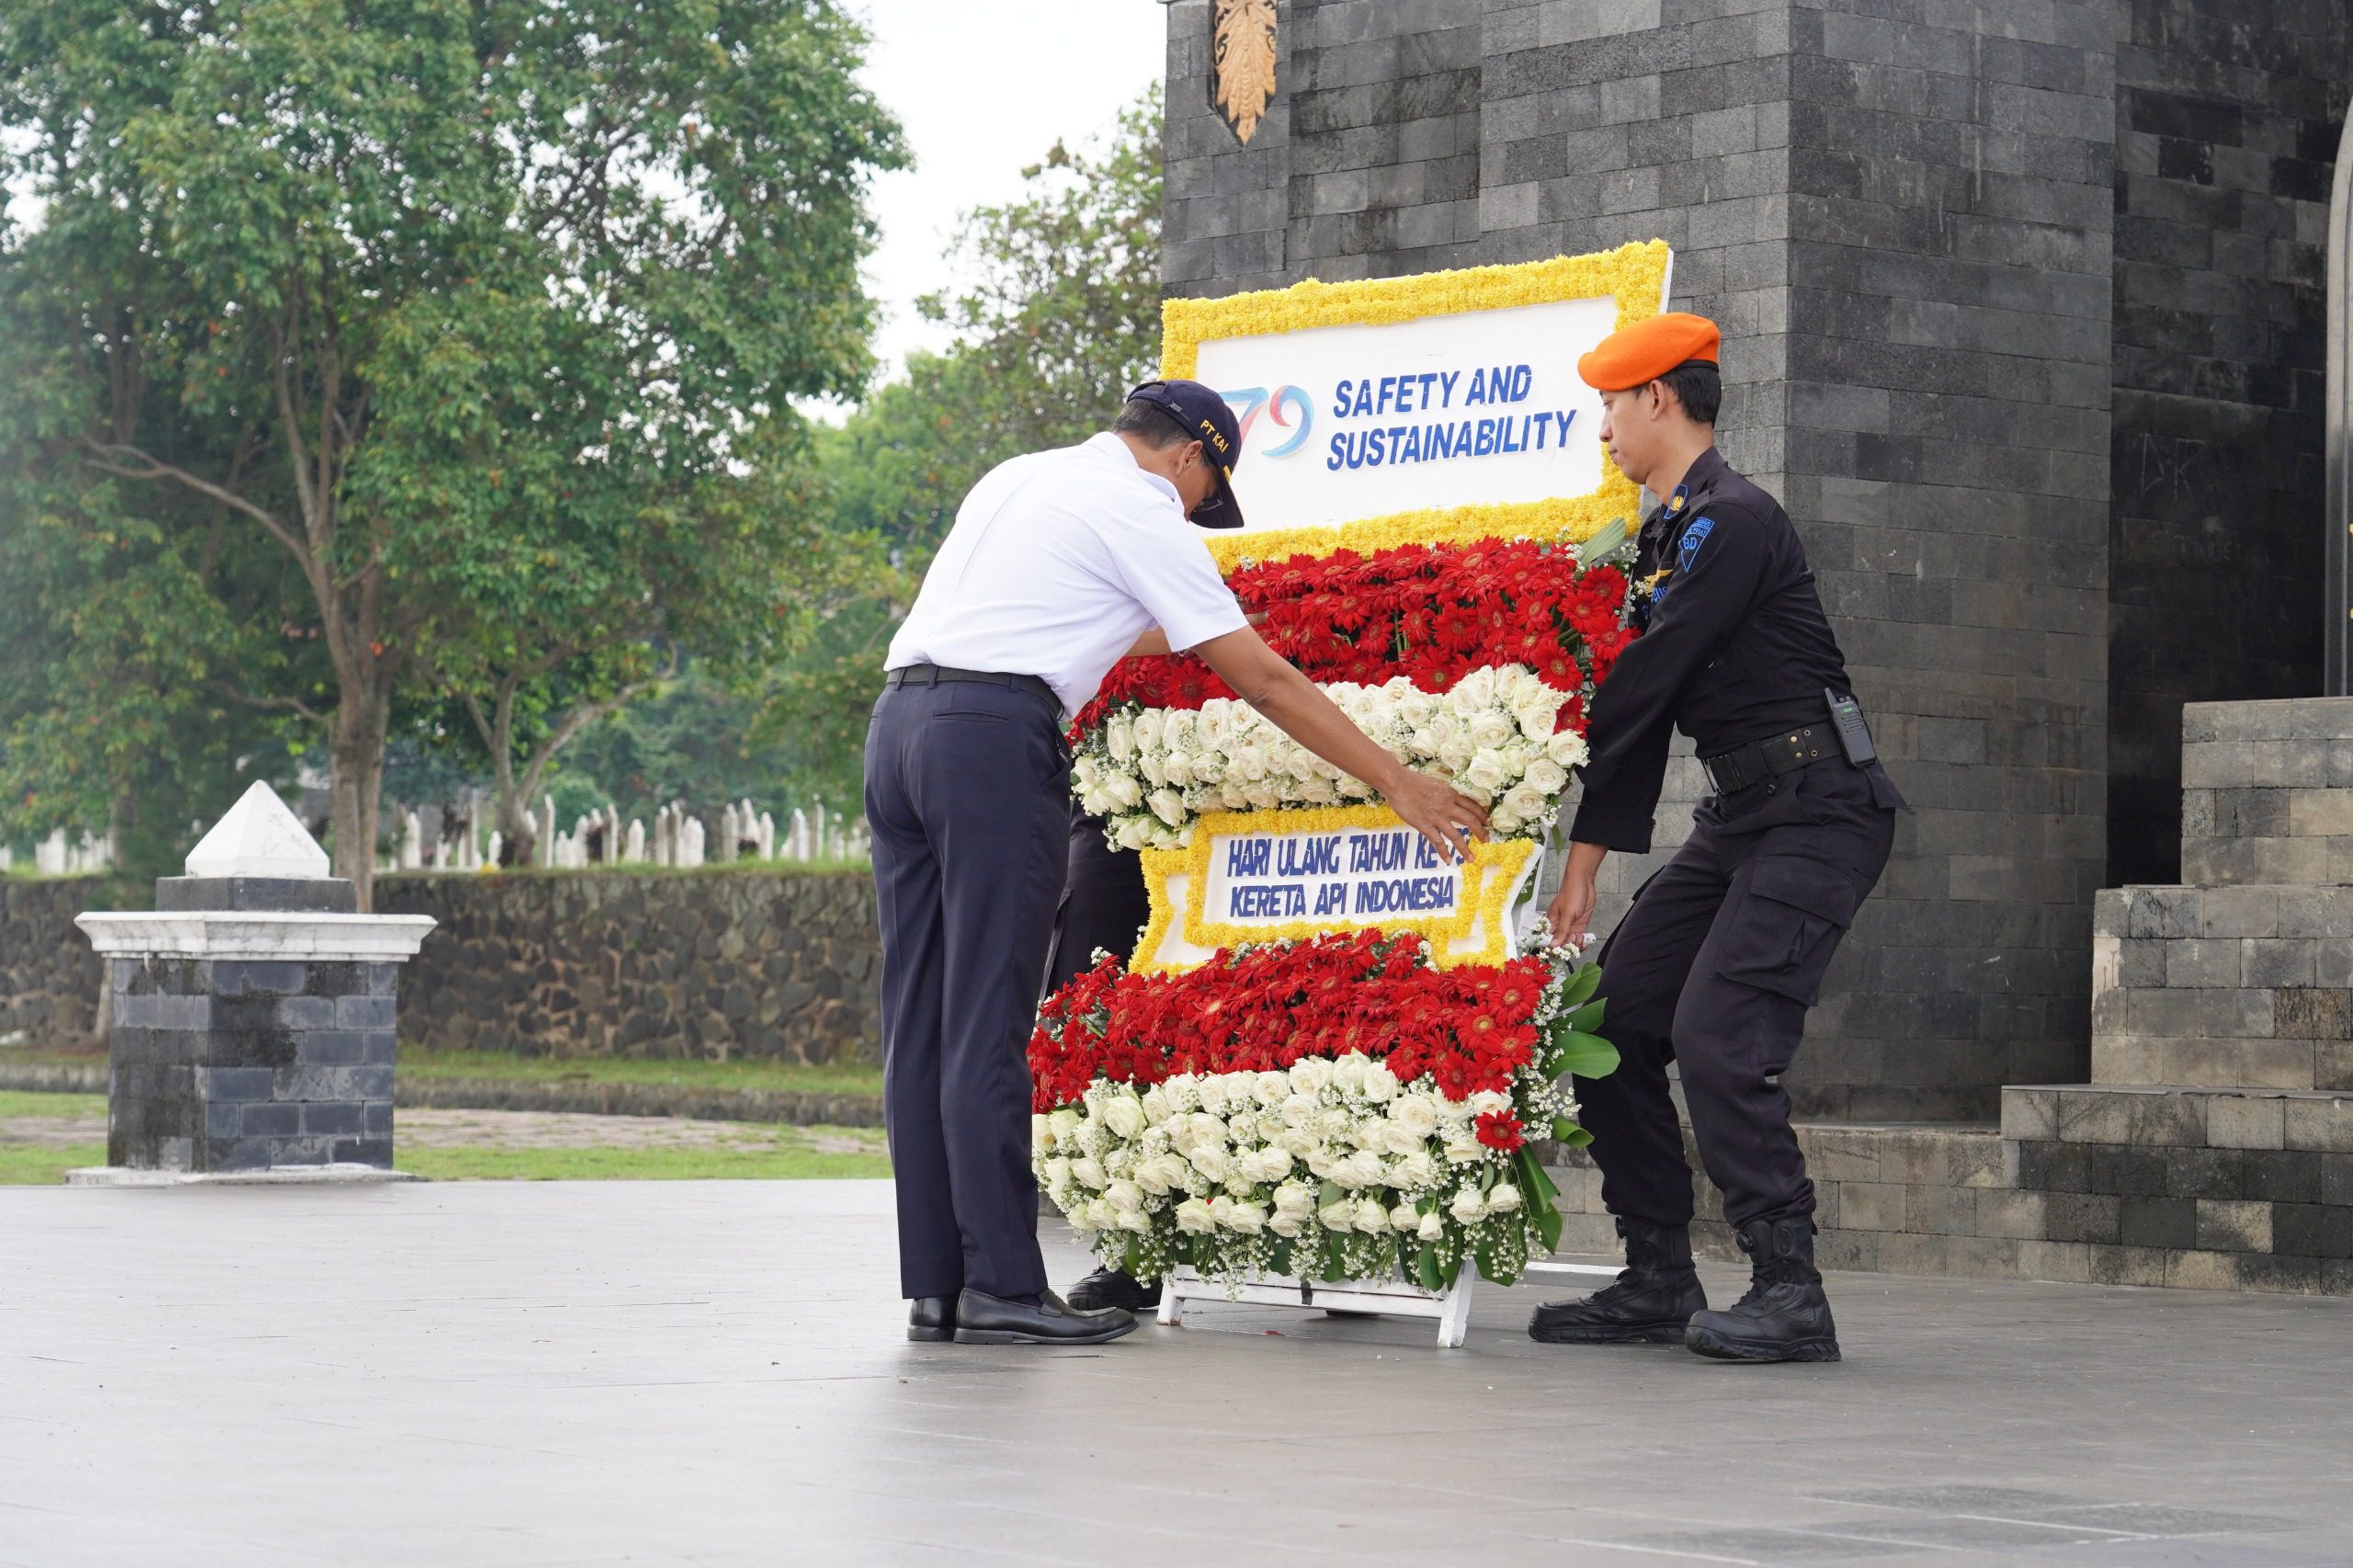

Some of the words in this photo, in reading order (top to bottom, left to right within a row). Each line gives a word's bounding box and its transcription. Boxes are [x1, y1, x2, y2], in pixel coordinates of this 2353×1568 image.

[1333, 370, 1460, 418] SAFETY
[1465, 364, 1532, 406] AND
[1199, 419, 1216, 436] PT
[1211, 432, 1229, 453] KAI
[1218, 384, 1314, 457] 79
[1326, 409, 1577, 471] SUSTAINABILITY
[1227, 838, 1272, 878] HARI
[1277, 835, 1342, 876] ULANG
[1348, 832, 1410, 873] TAHUN
[1230, 884, 1306, 917] KERETA
[1313, 882, 1348, 915] API
[1355, 875, 1454, 913] INDONESIA
